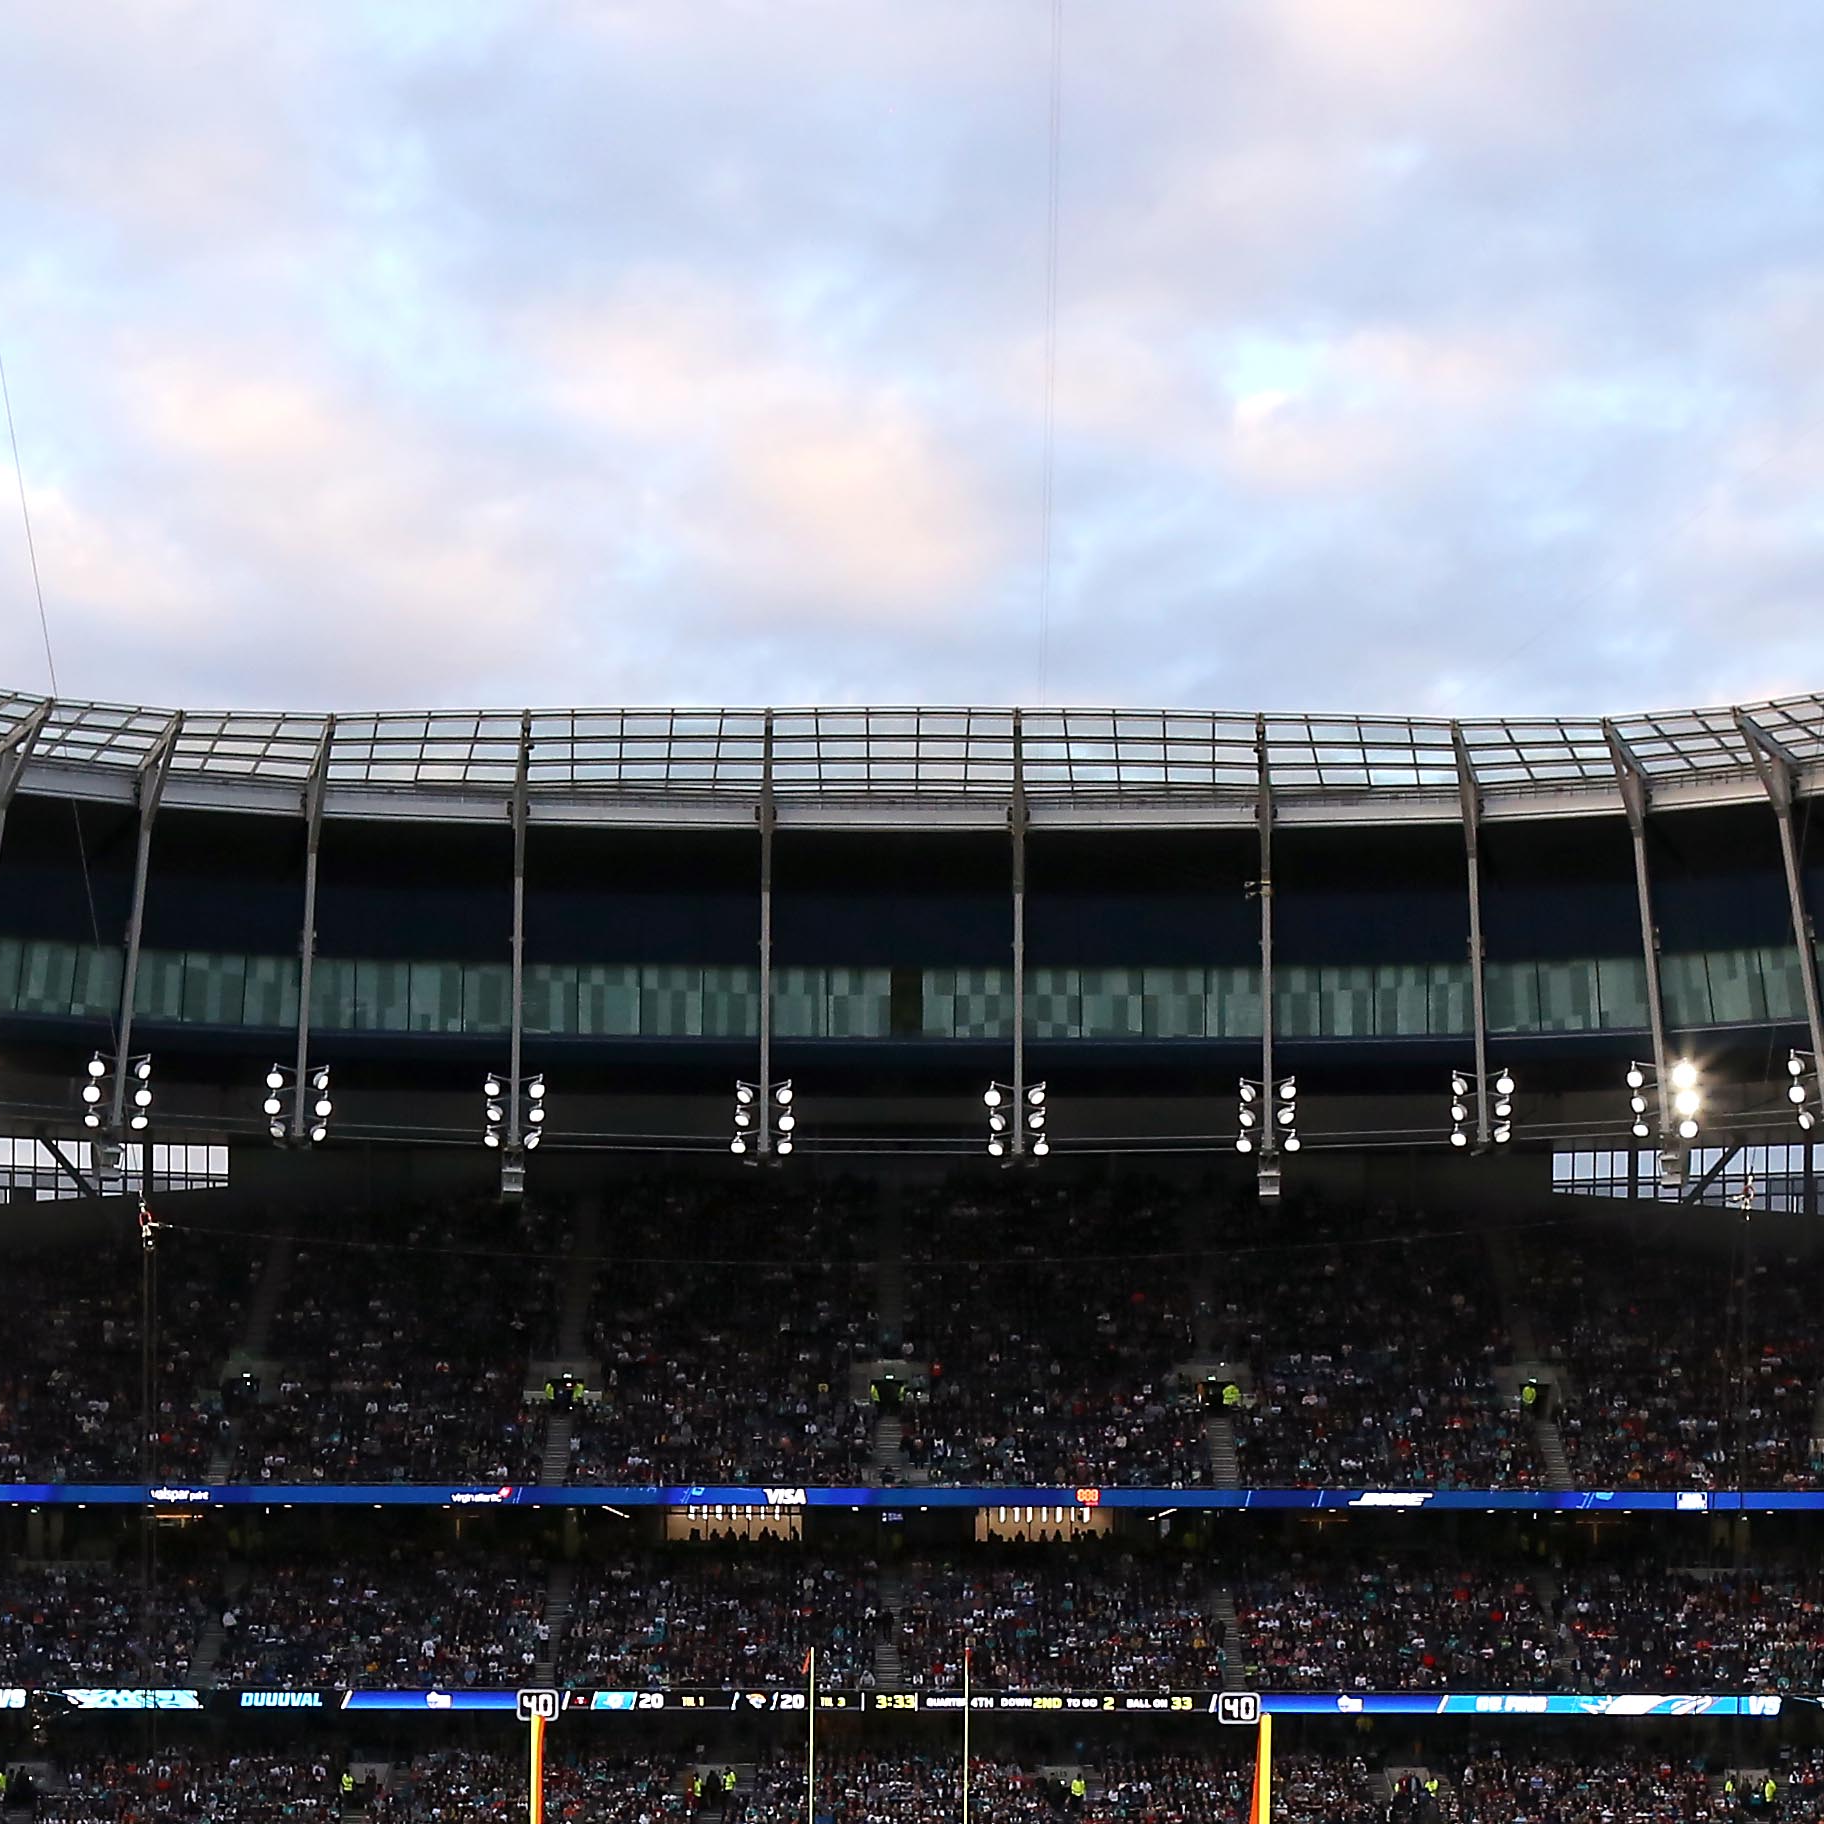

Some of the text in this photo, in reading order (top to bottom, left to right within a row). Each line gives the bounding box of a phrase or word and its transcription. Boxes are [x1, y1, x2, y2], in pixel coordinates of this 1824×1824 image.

[763, 1488, 807, 1505] VISA
[241, 1692, 323, 1706] DUUUVAL
[523, 1695, 553, 1716] 40
[639, 1693, 664, 1709] 20
[780, 1694, 804, 1709] 20
[876, 1694, 914, 1708] 3:33
[970, 1698, 993, 1708] 4TH
[1001, 1698, 1032, 1708] DOWN
[1033, 1697, 1062, 1709] 2ND
[1067, 1699, 1081, 1708] TO
[1103, 1697, 1115, 1710] 2
[1126, 1699, 1152, 1709] BALL
[1153, 1699, 1168, 1709] ON
[1171, 1697, 1192, 1710] 33
[1749, 1695, 1781, 1715] VS
[1224, 1698, 1255, 1719] 40
